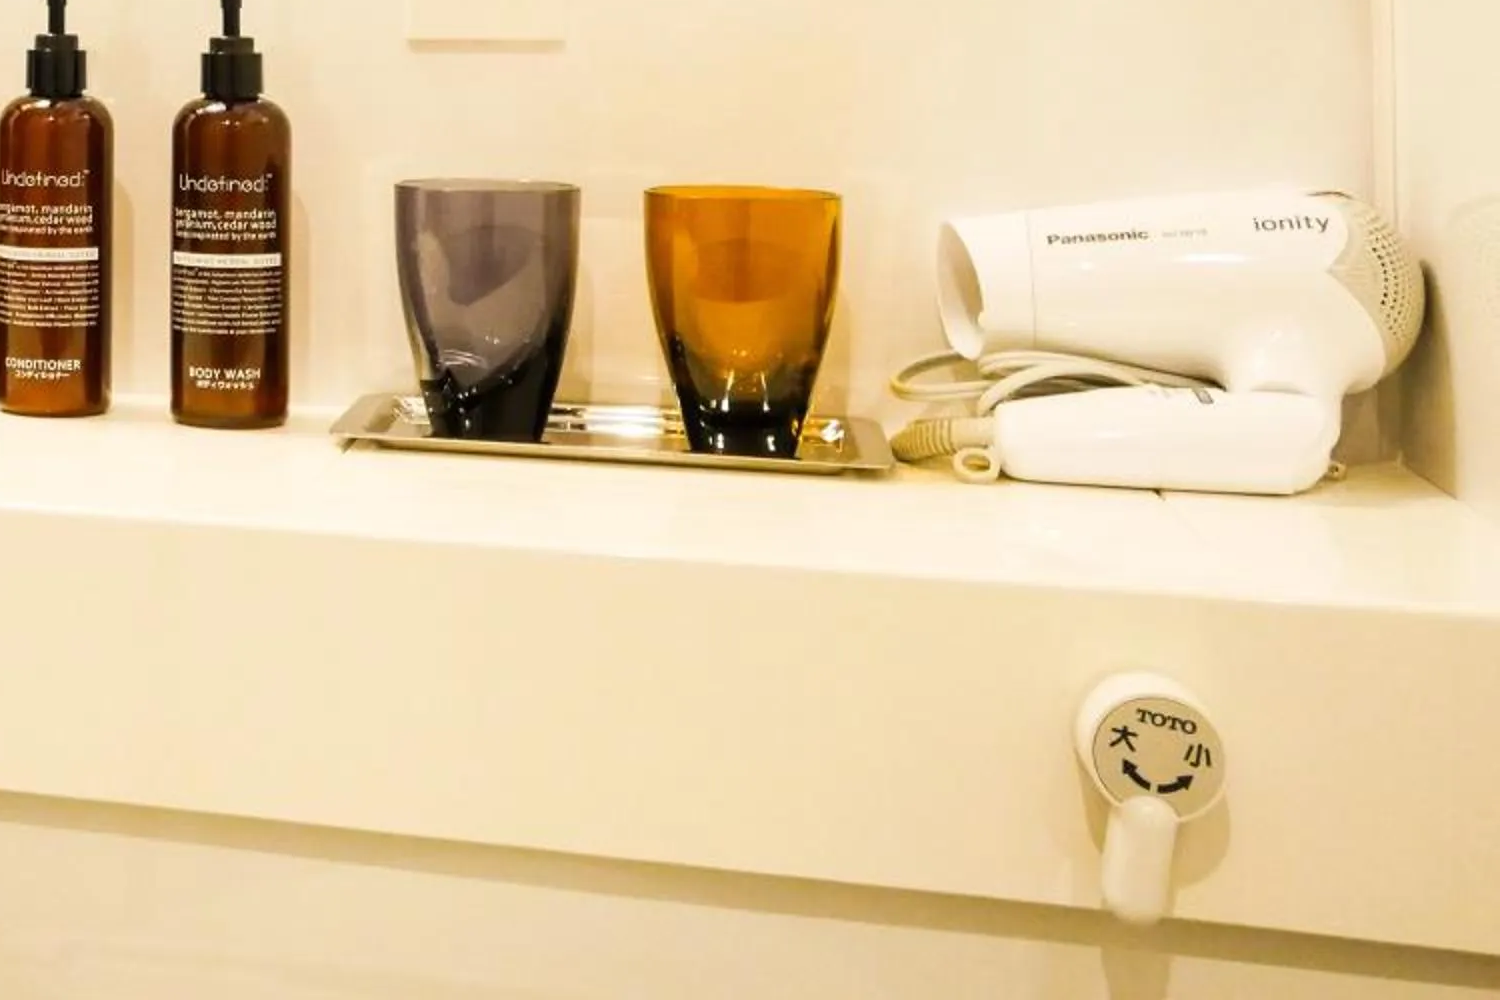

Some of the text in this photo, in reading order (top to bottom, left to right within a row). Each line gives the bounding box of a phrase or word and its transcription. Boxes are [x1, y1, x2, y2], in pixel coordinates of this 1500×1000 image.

[224, 208, 277, 219] mandarin
[250, 218, 277, 229] wood
[1252, 215, 1329, 234] ionity
[1046, 228, 1150, 245] Panasonic
[5, 357, 81, 371] CONDITIONER
[189, 366, 261, 380] BODY WASH
[1136, 708, 1197, 735] TOTO
[1109, 725, 1138, 752] 大
[1184, 743, 1212, 768] 小
